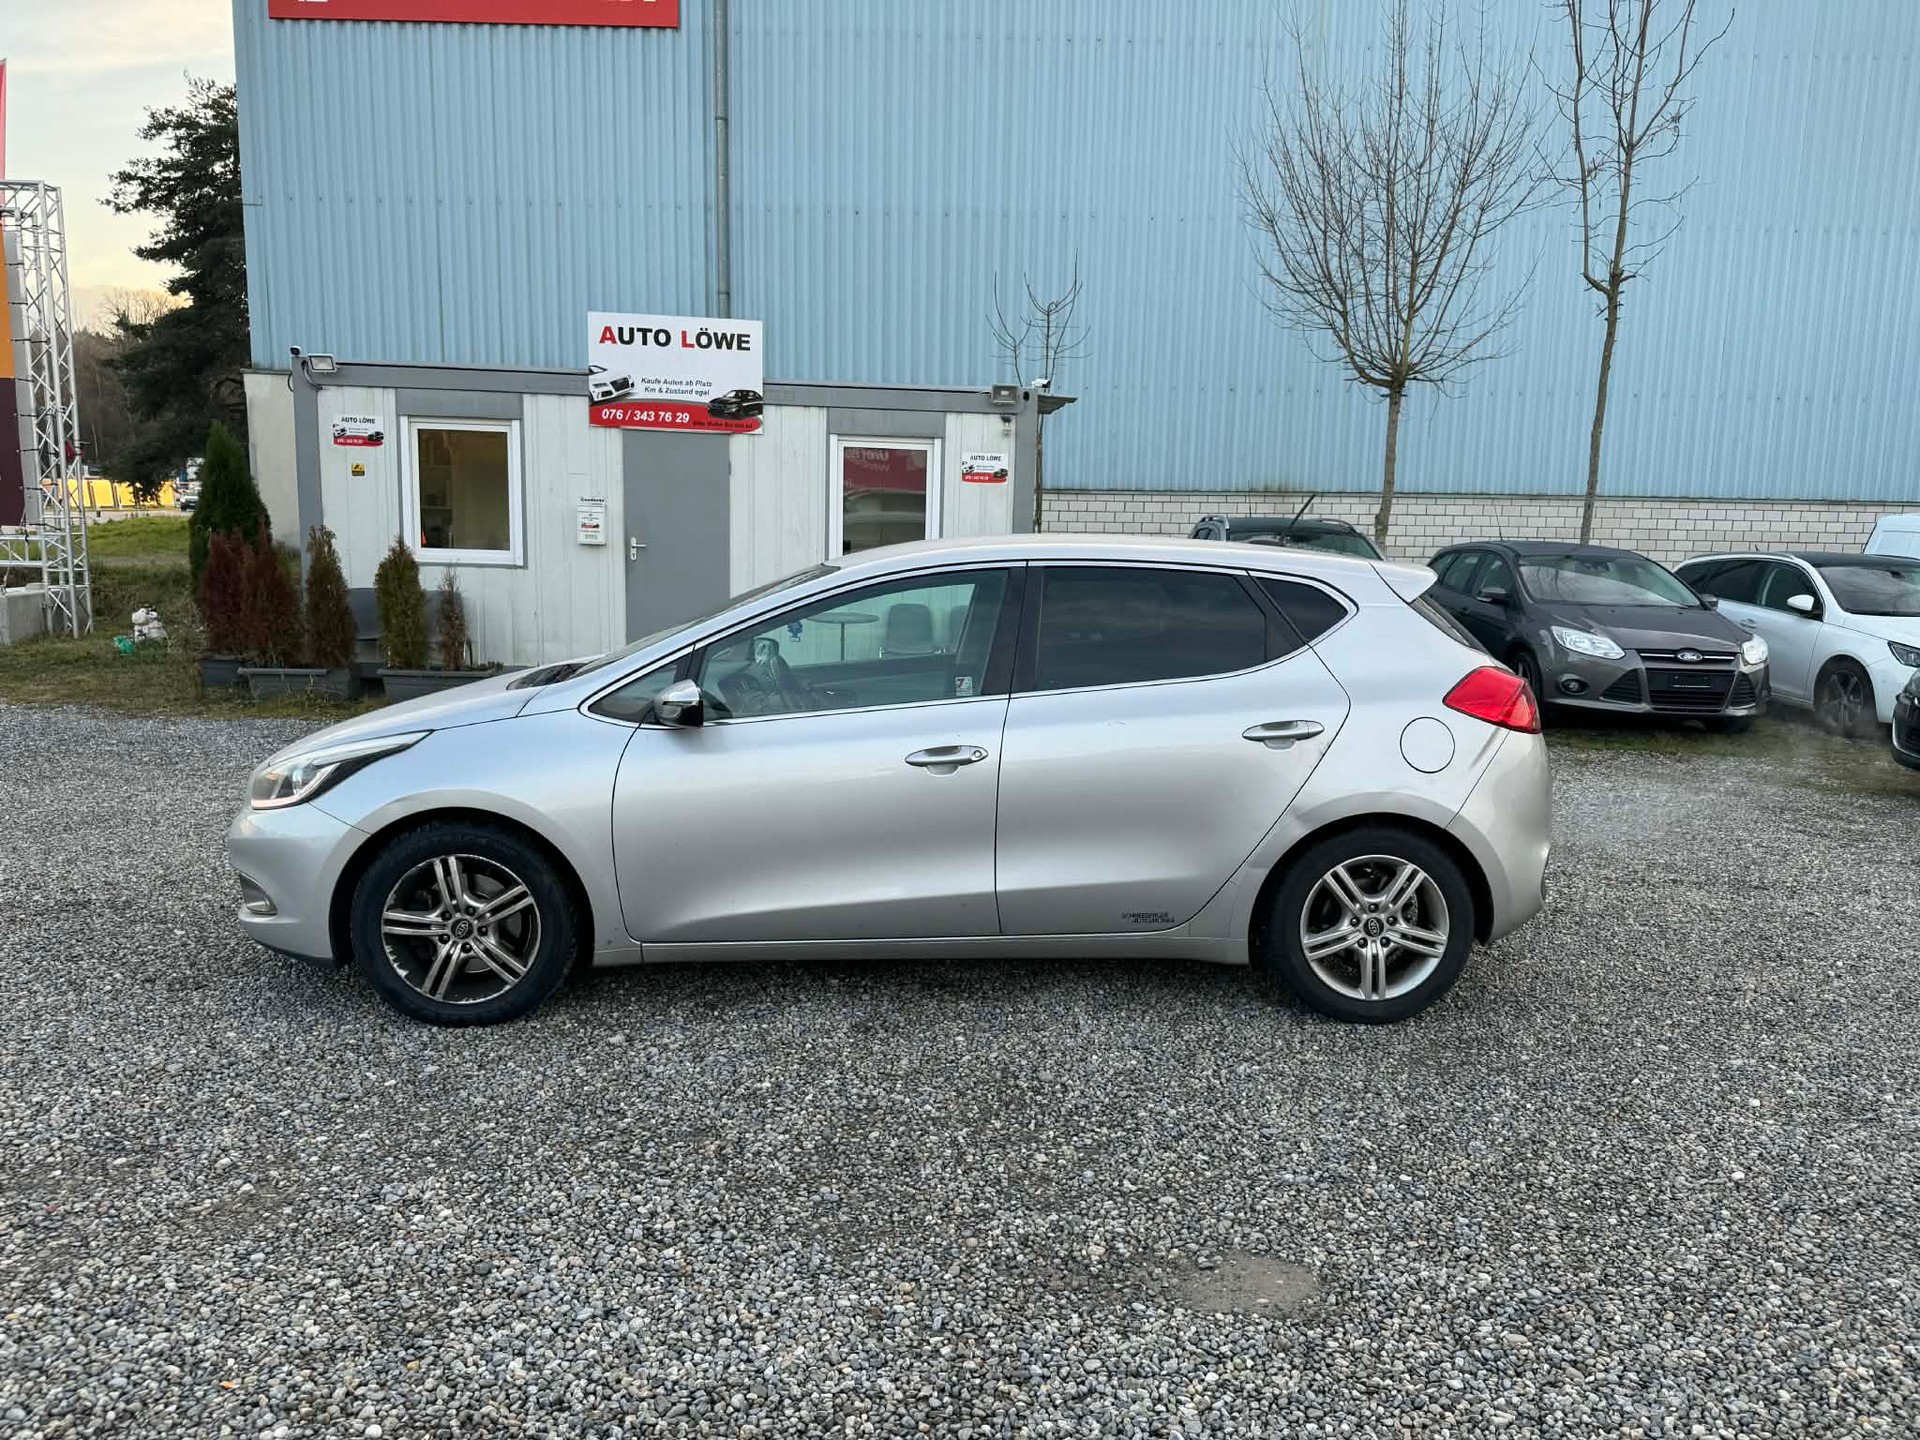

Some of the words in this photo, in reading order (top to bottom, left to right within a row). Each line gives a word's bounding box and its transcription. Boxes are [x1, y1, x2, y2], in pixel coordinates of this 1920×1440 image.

[599, 325, 672, 348] AUTO
[681, 328, 751, 351] LÖWE
[640, 377, 662, 386] Kaufe
[663, 378, 684, 386] Autos
[665, 387, 694, 395] Zustand
[694, 389, 710, 397] egal
[602, 408, 624, 420] 076
[625, 409, 632, 421] /
[633, 411, 655, 421] 343
[658, 412, 672, 422] 76
[675, 413, 690, 424] 29
